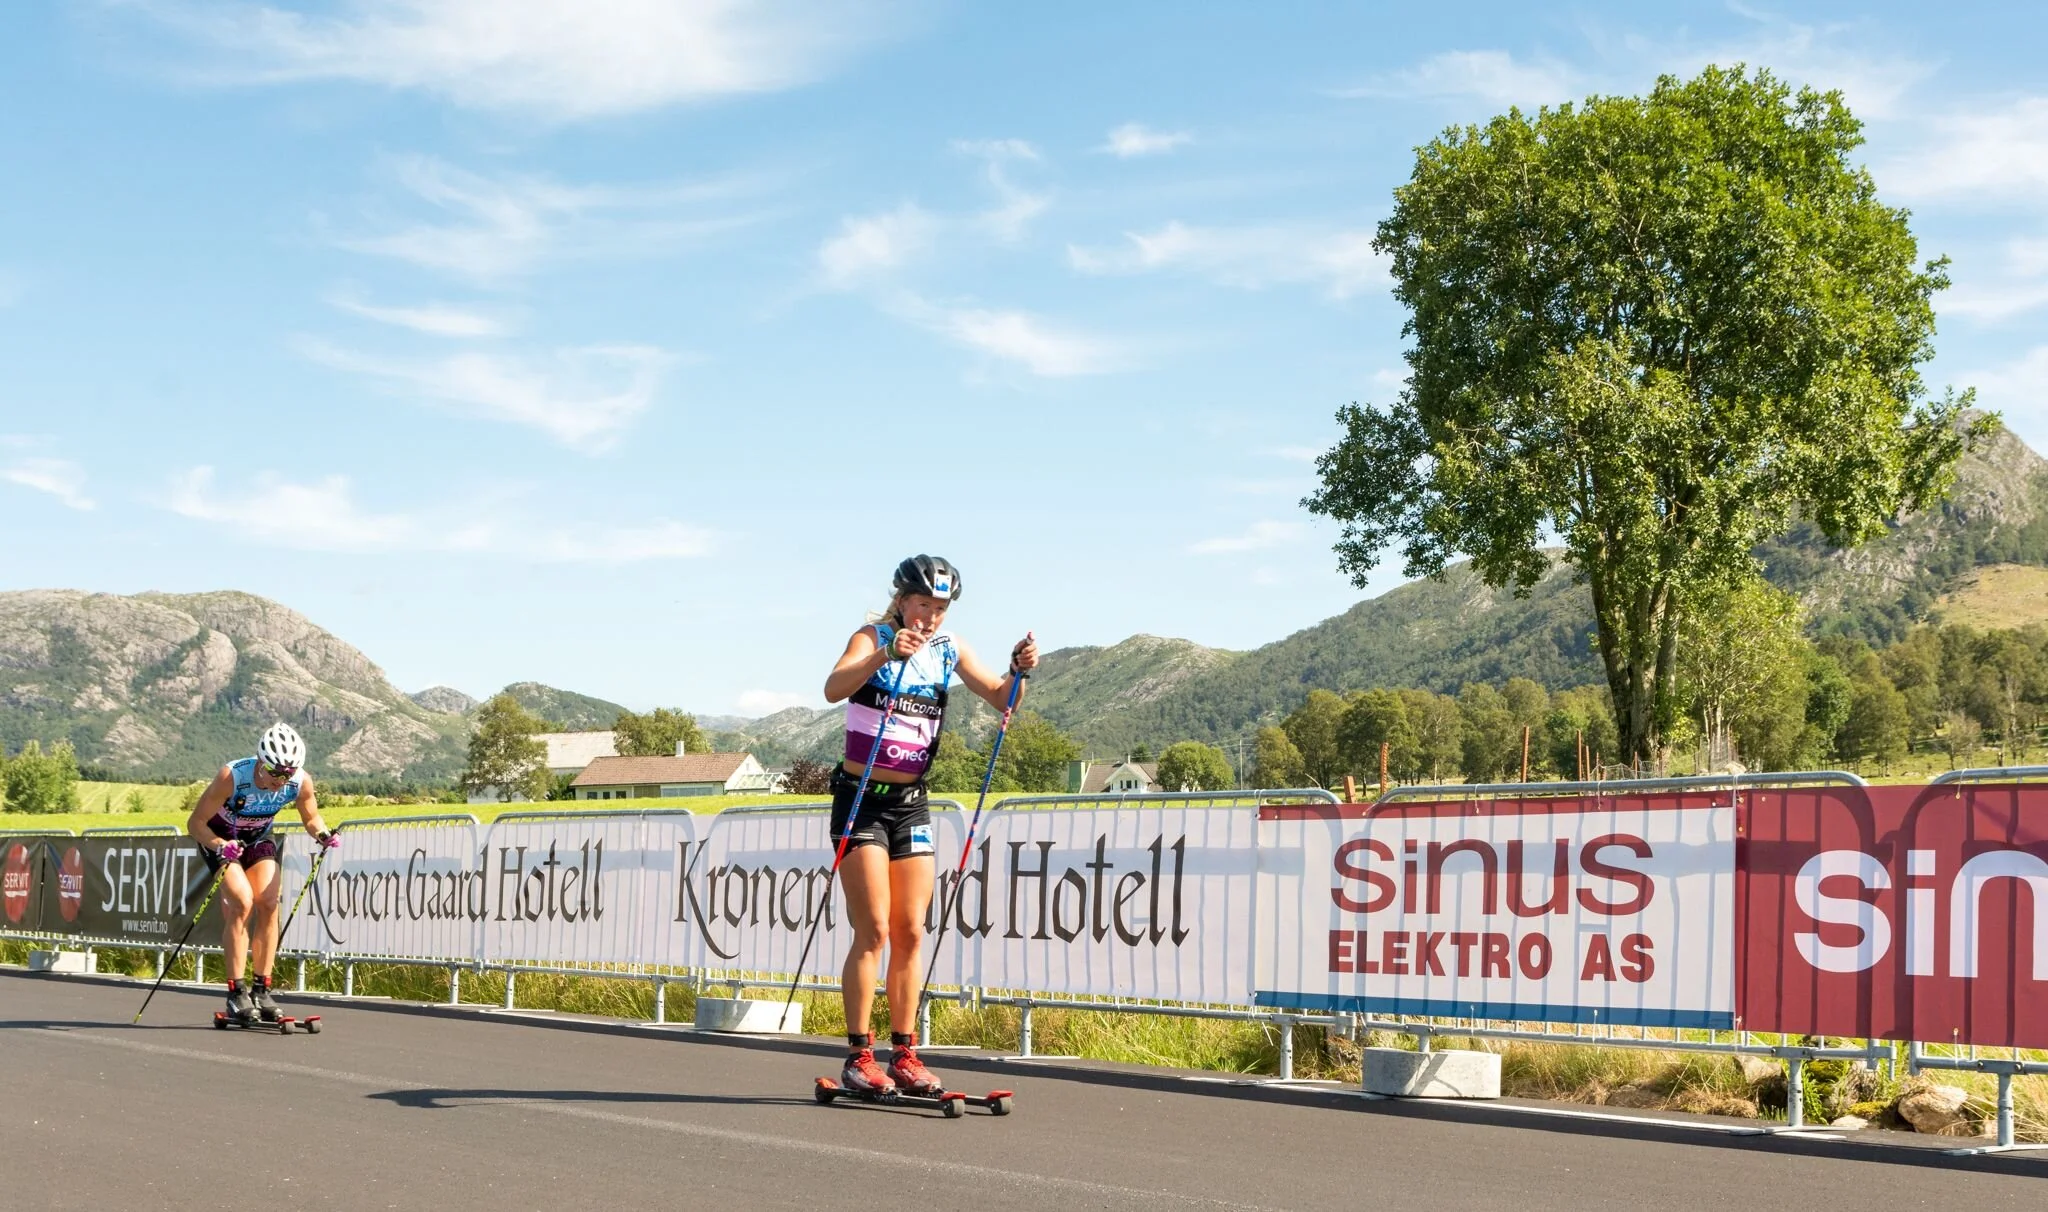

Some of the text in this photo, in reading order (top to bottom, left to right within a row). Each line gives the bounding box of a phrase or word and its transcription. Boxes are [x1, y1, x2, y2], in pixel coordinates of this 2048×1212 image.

[257, 791, 286, 803] VVS
[4, 872, 31, 889] SERVIT
[59, 873, 84, 891] SERVIT
[102, 846, 198, 916] SERVIT
[307, 837, 605, 945] Kronen Gaard Hotell
[673, 837, 837, 960] Kronen
[1003, 832, 1190, 949] Hotell
[1330, 831, 1656, 918] sinus
[122, 916, 168, 934] www.servit.no
[1328, 928, 1656, 984] ELEKTRO AS
